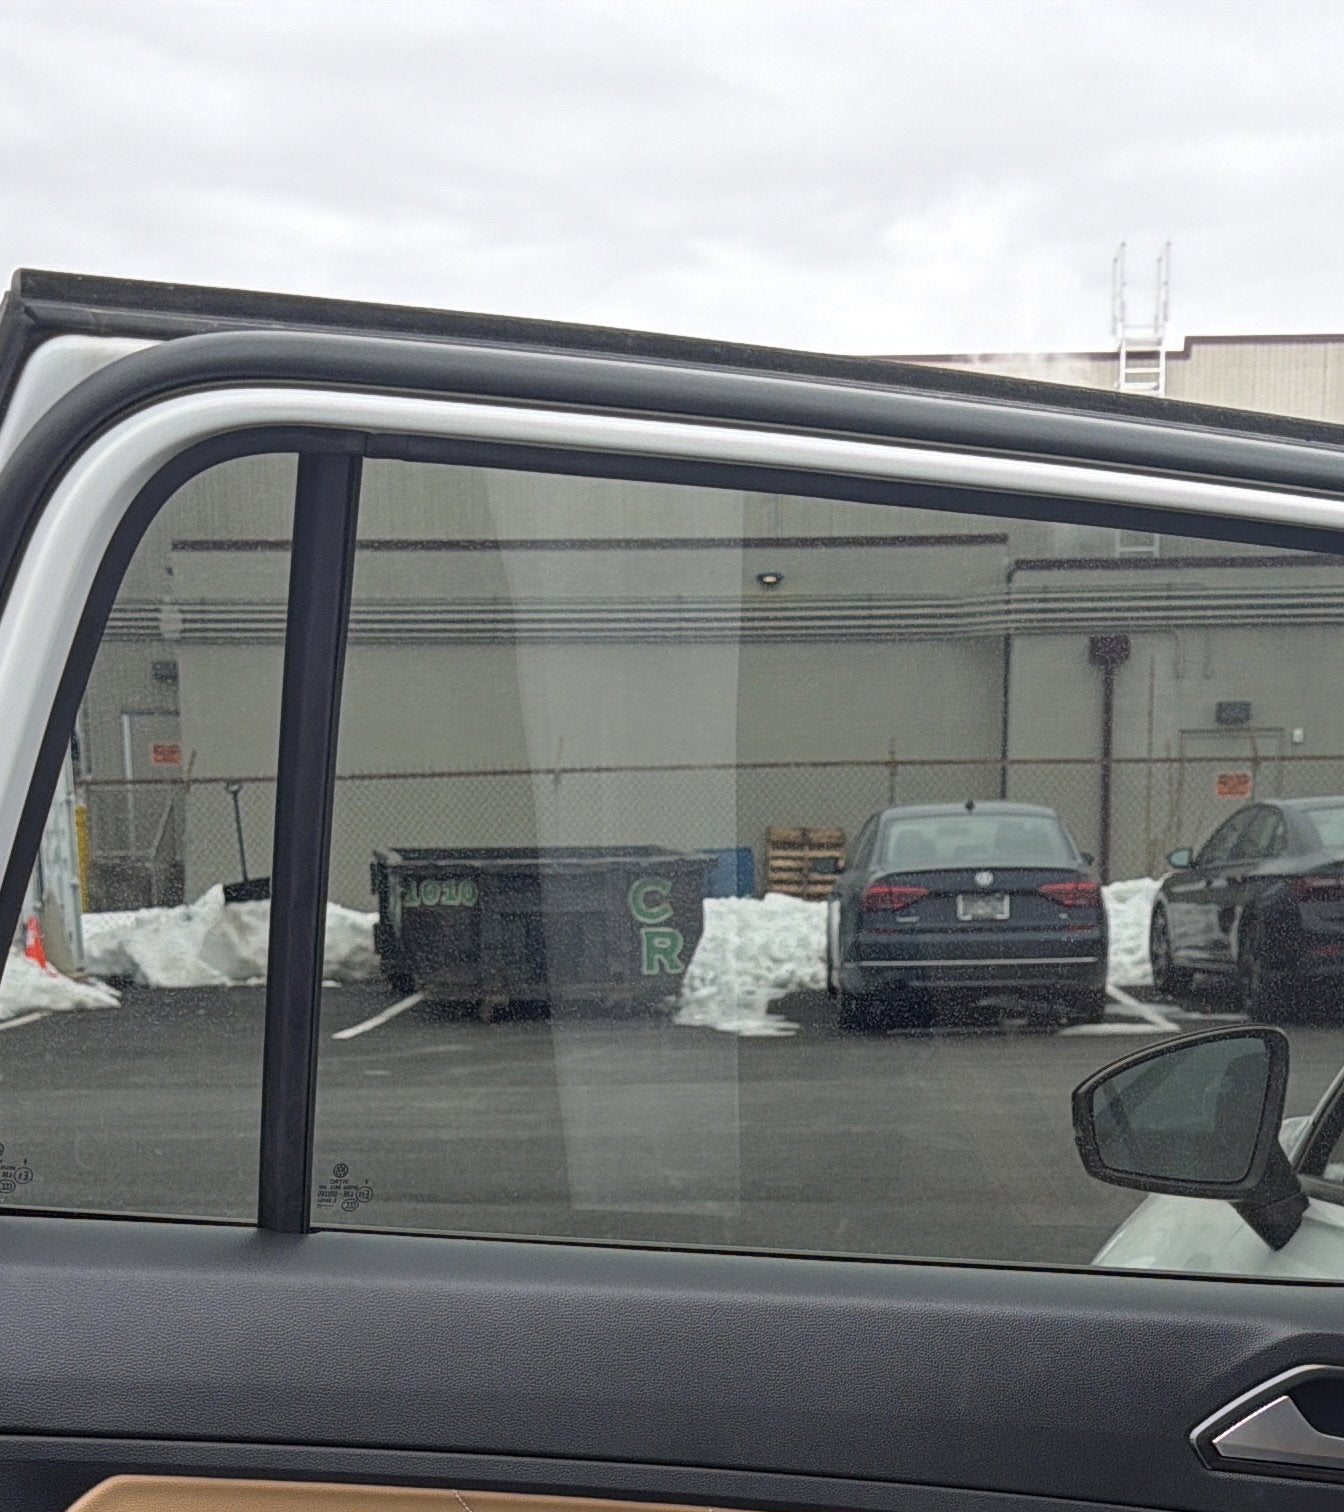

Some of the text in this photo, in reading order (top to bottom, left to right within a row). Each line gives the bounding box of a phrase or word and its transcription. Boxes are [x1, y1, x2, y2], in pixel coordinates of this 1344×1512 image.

[403, 879, 479, 907] 1010
[628, 878, 674, 924] C
[640, 926, 685, 975] R
